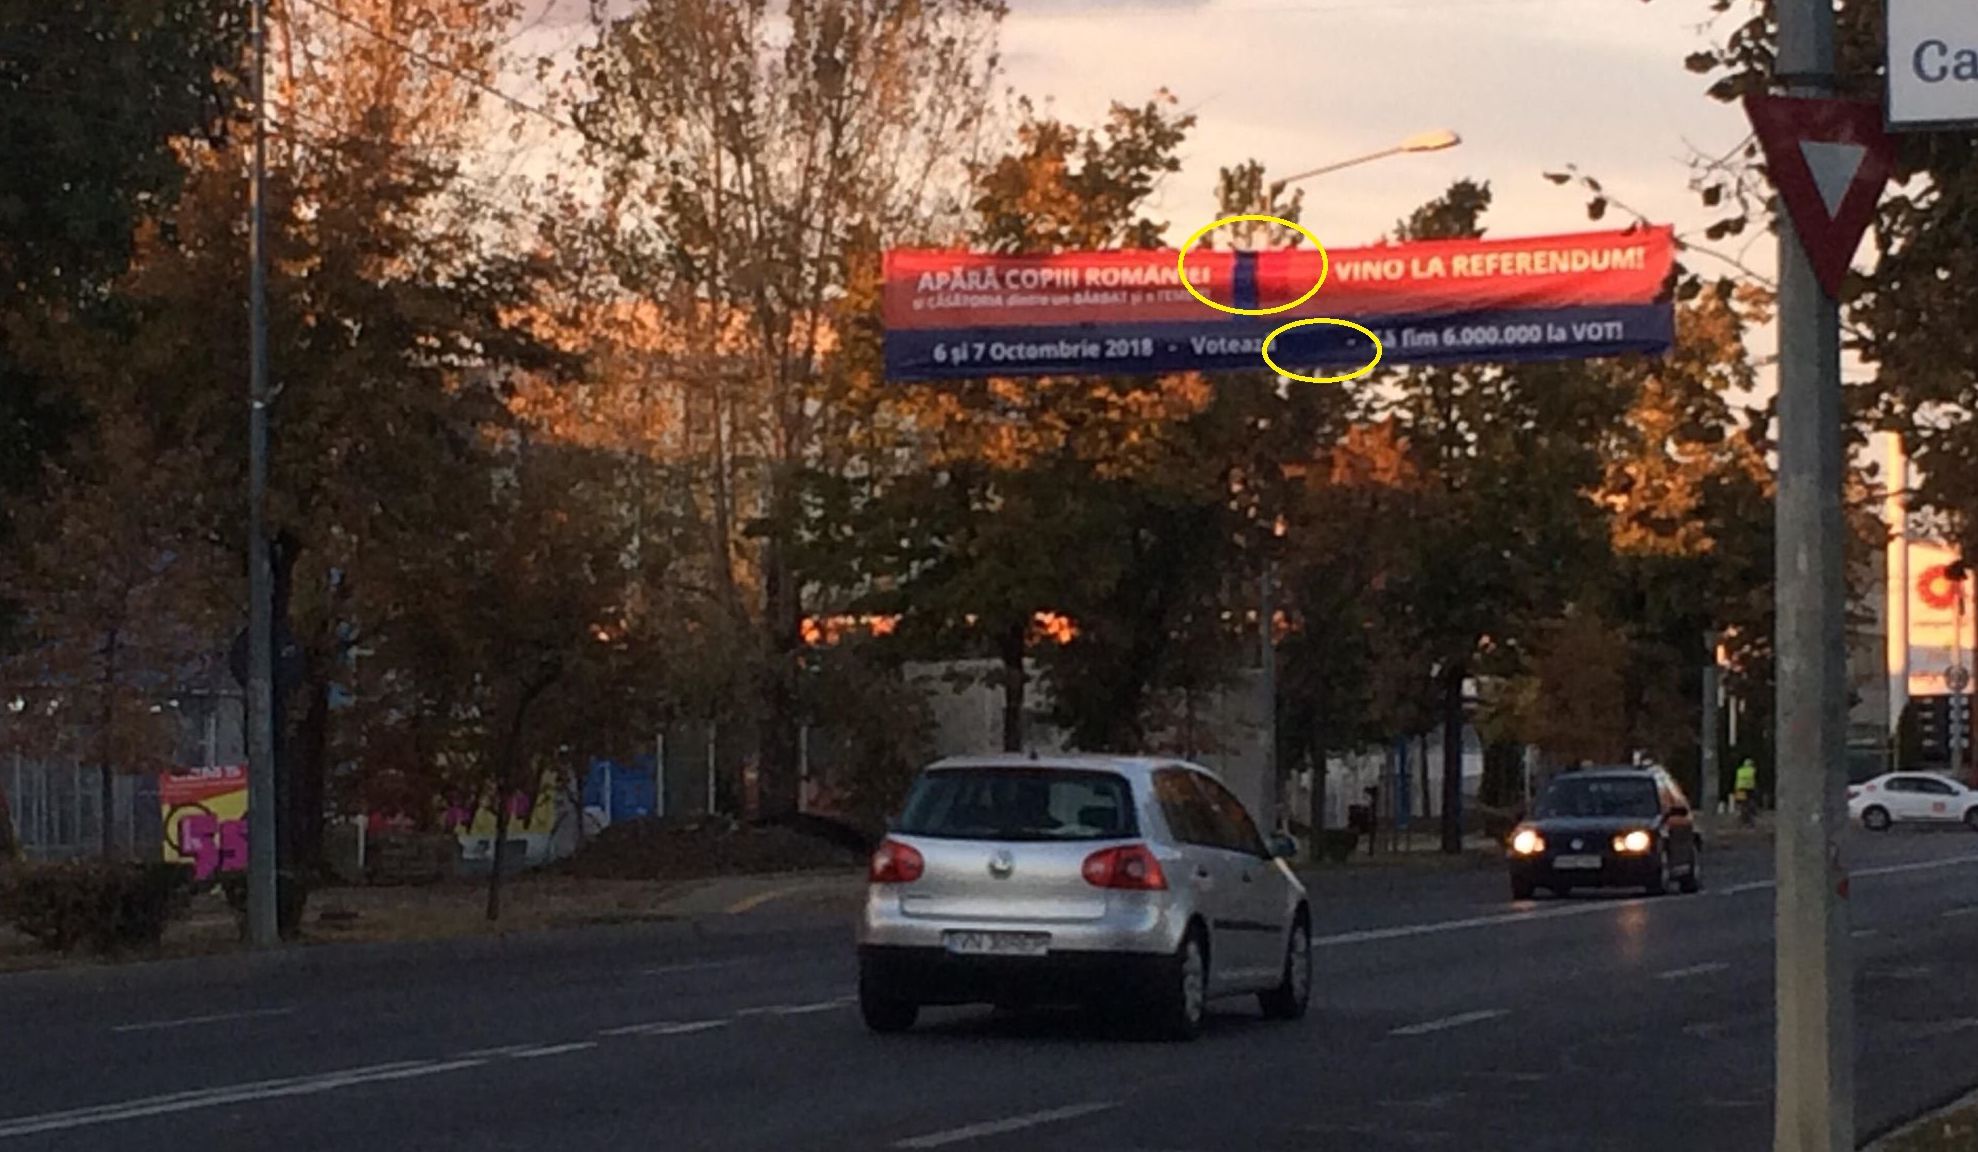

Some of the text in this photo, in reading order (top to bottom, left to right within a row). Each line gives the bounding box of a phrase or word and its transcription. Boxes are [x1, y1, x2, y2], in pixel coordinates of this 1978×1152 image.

[1005, 267, 1080, 290] COPIII
[1334, 246, 1646, 282] VINO LA REFERENDUM!
[933, 342, 947, 363] 6
[972, 342, 986, 361] 7
[989, 338, 1102, 361] Octombrie
[1104, 337, 1154, 358] 2018
[1401, 327, 1438, 348] fim
[1442, 323, 1542, 347] 6.000.000
[1547, 322, 1567, 343] la
[1571, 321, 1624, 342] VOT!
